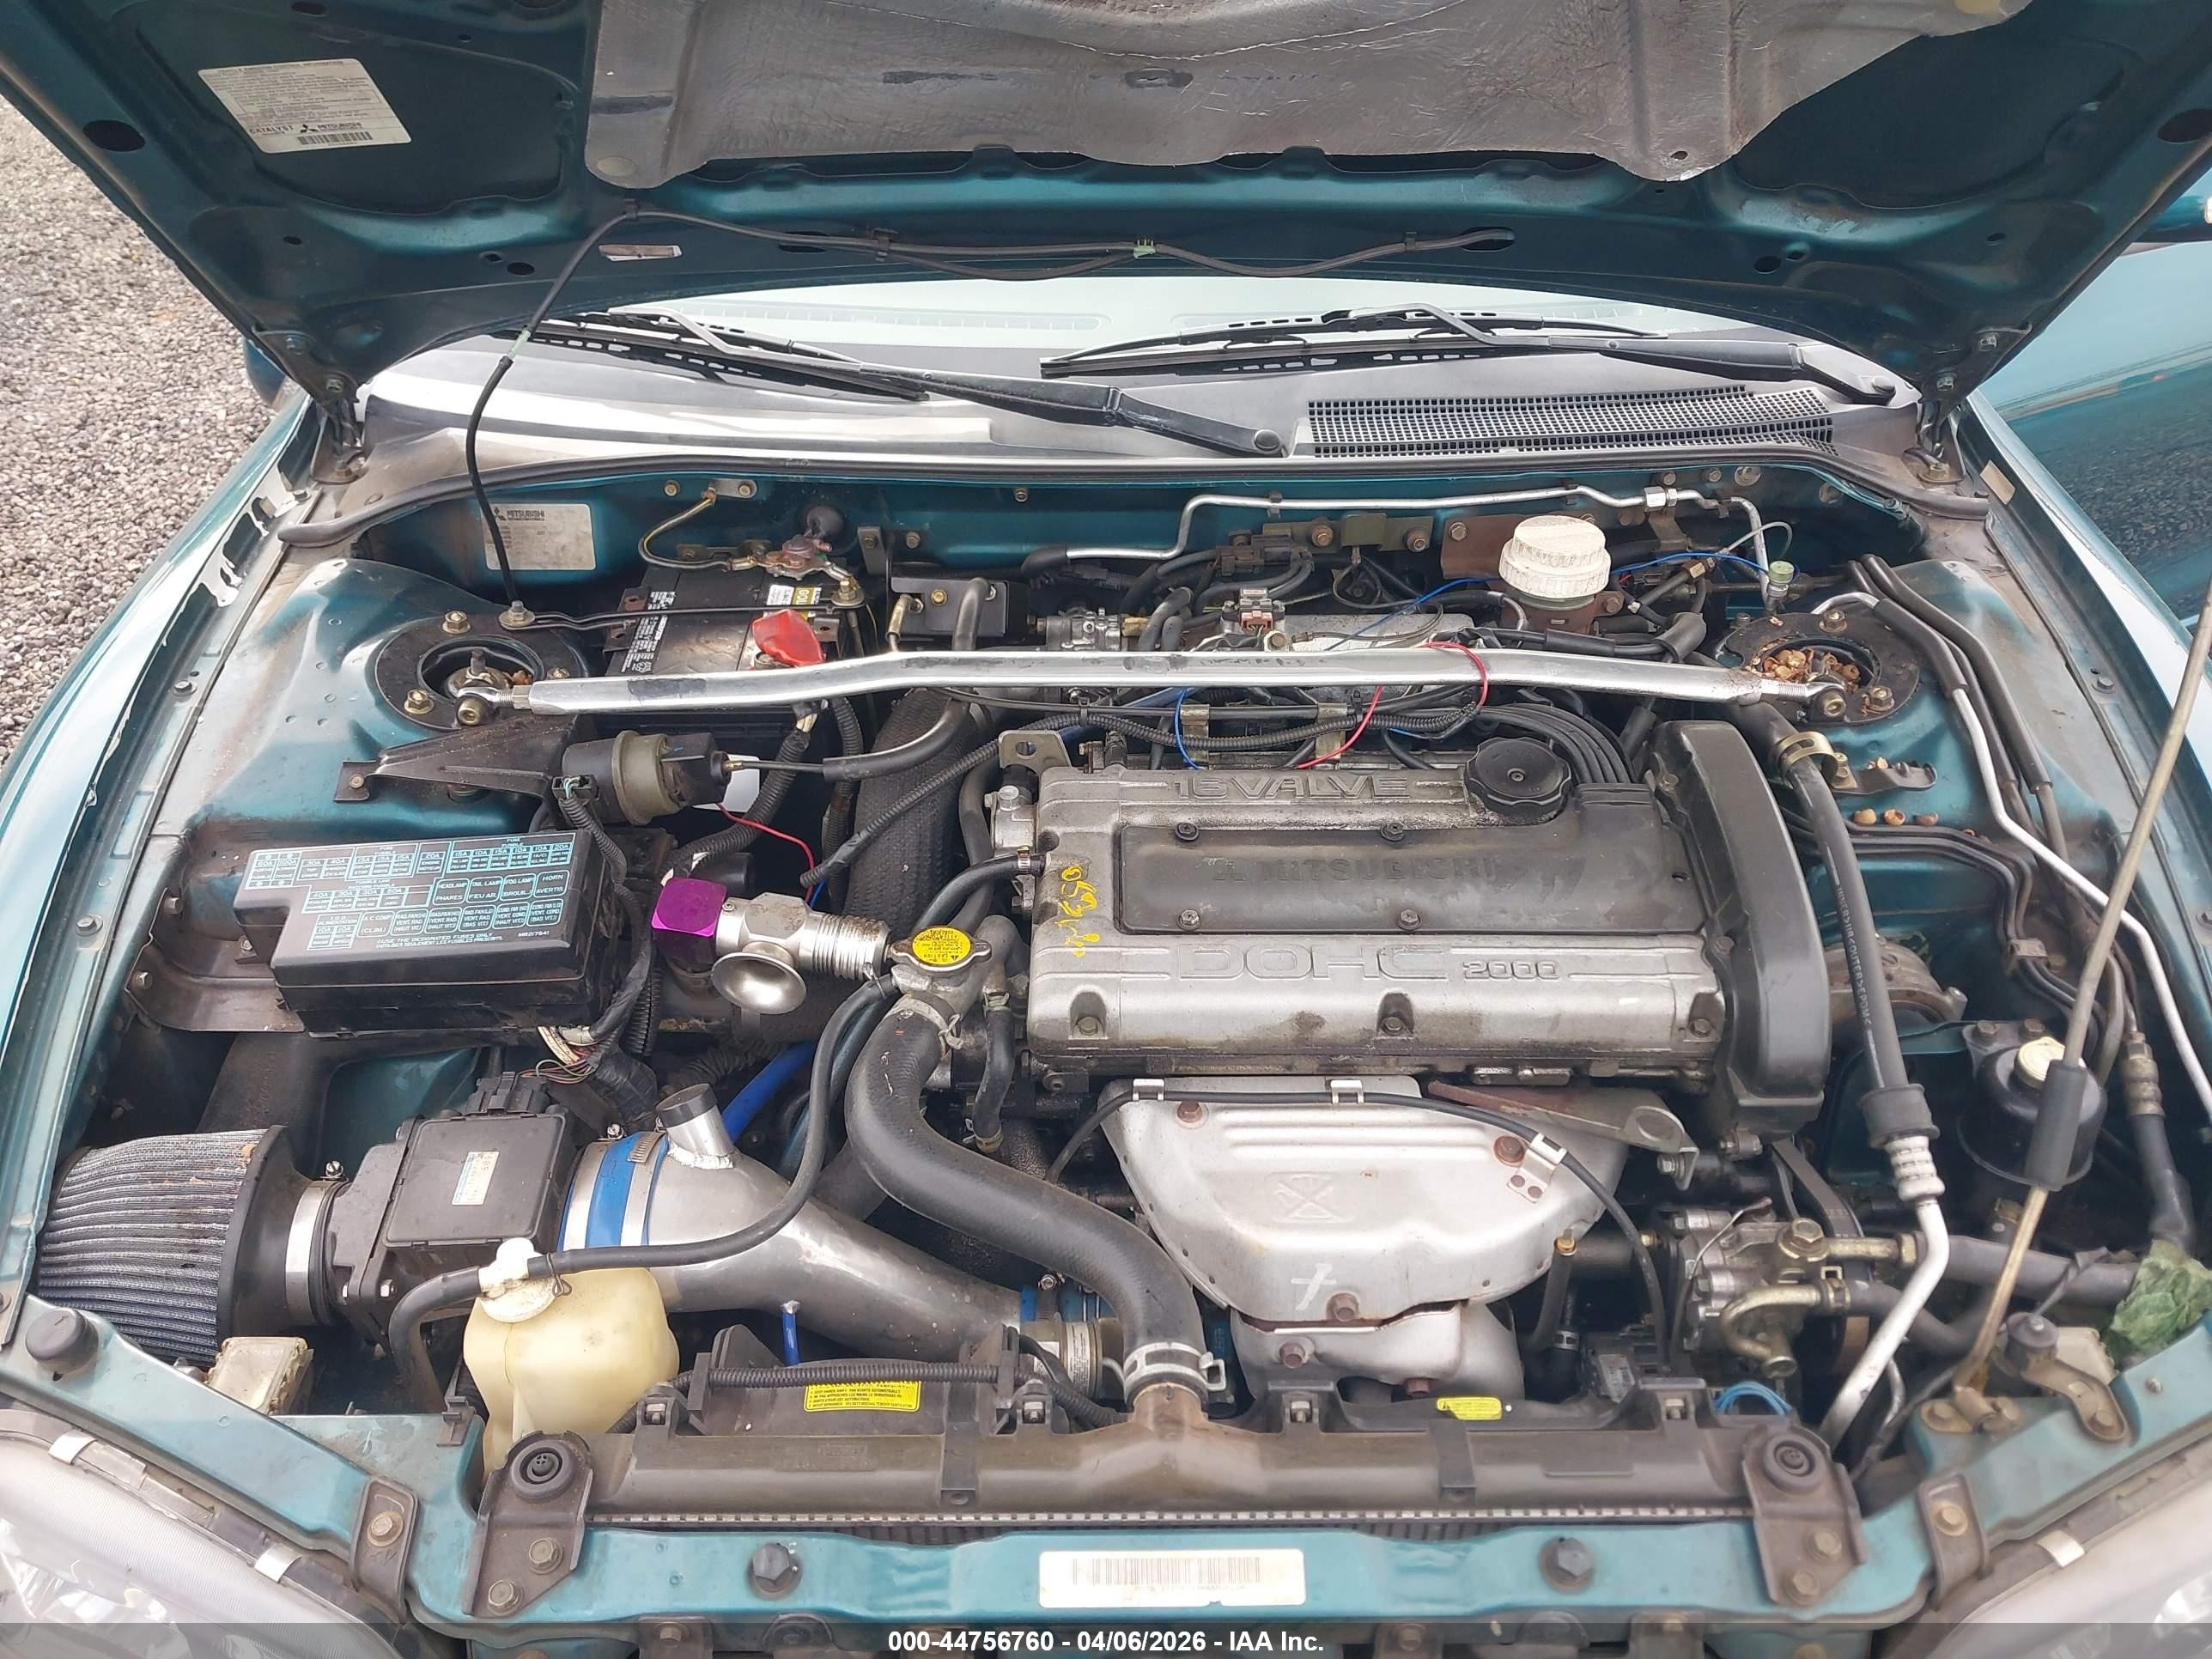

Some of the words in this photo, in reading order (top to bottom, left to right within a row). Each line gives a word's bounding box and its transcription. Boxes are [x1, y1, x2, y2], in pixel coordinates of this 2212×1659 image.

[249, 125, 294, 134] CATALYST
[318, 122, 362, 131] MITSUBISHI
[507, 509, 545, 518] MITSUBISHI
[1258, 858, 1498, 881] MITSUBISHI
[1179, 945, 1448, 980] DOHC
[1462, 960, 1561, 981] 2000
